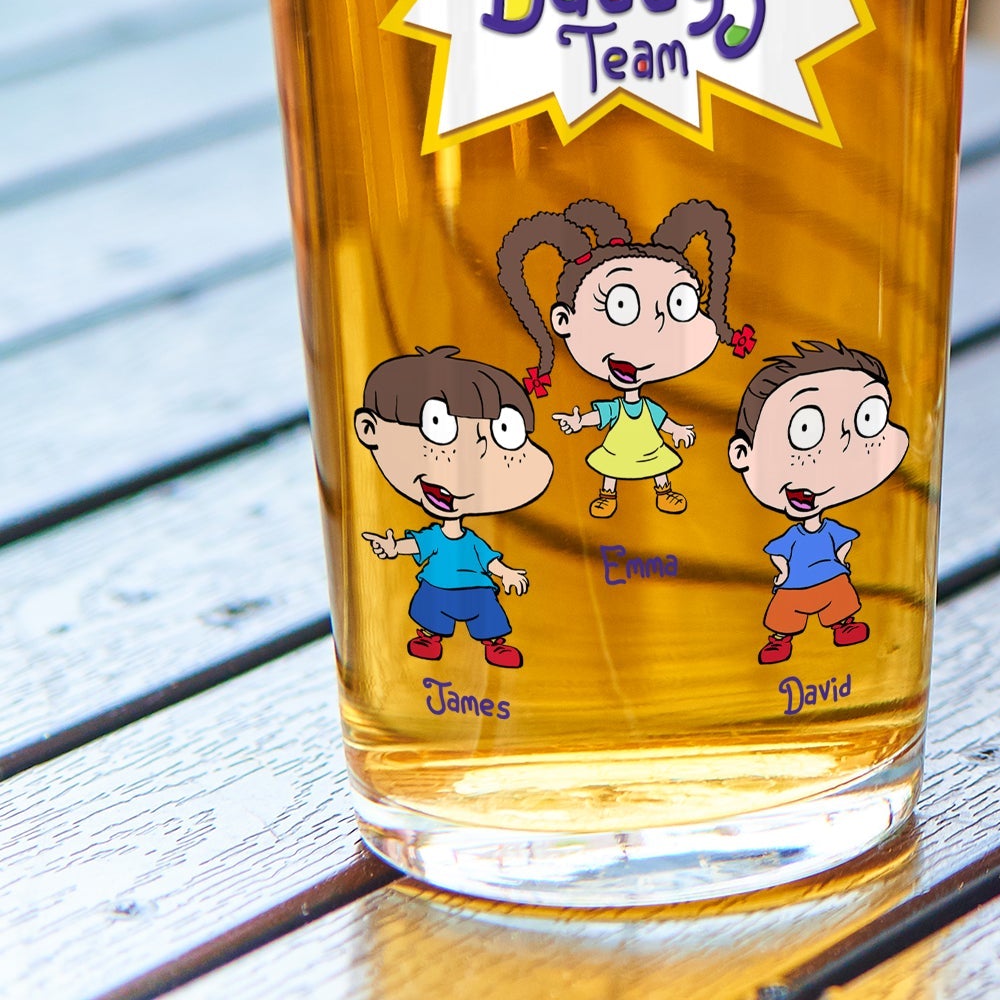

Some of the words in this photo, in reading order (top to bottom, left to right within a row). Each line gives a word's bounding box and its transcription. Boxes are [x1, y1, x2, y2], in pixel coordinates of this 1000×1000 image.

[557, 22, 689, 94] Team
[600, 545, 679, 586] Emma
[423, 677, 511, 720] James
[778, 674, 852, 716] David
